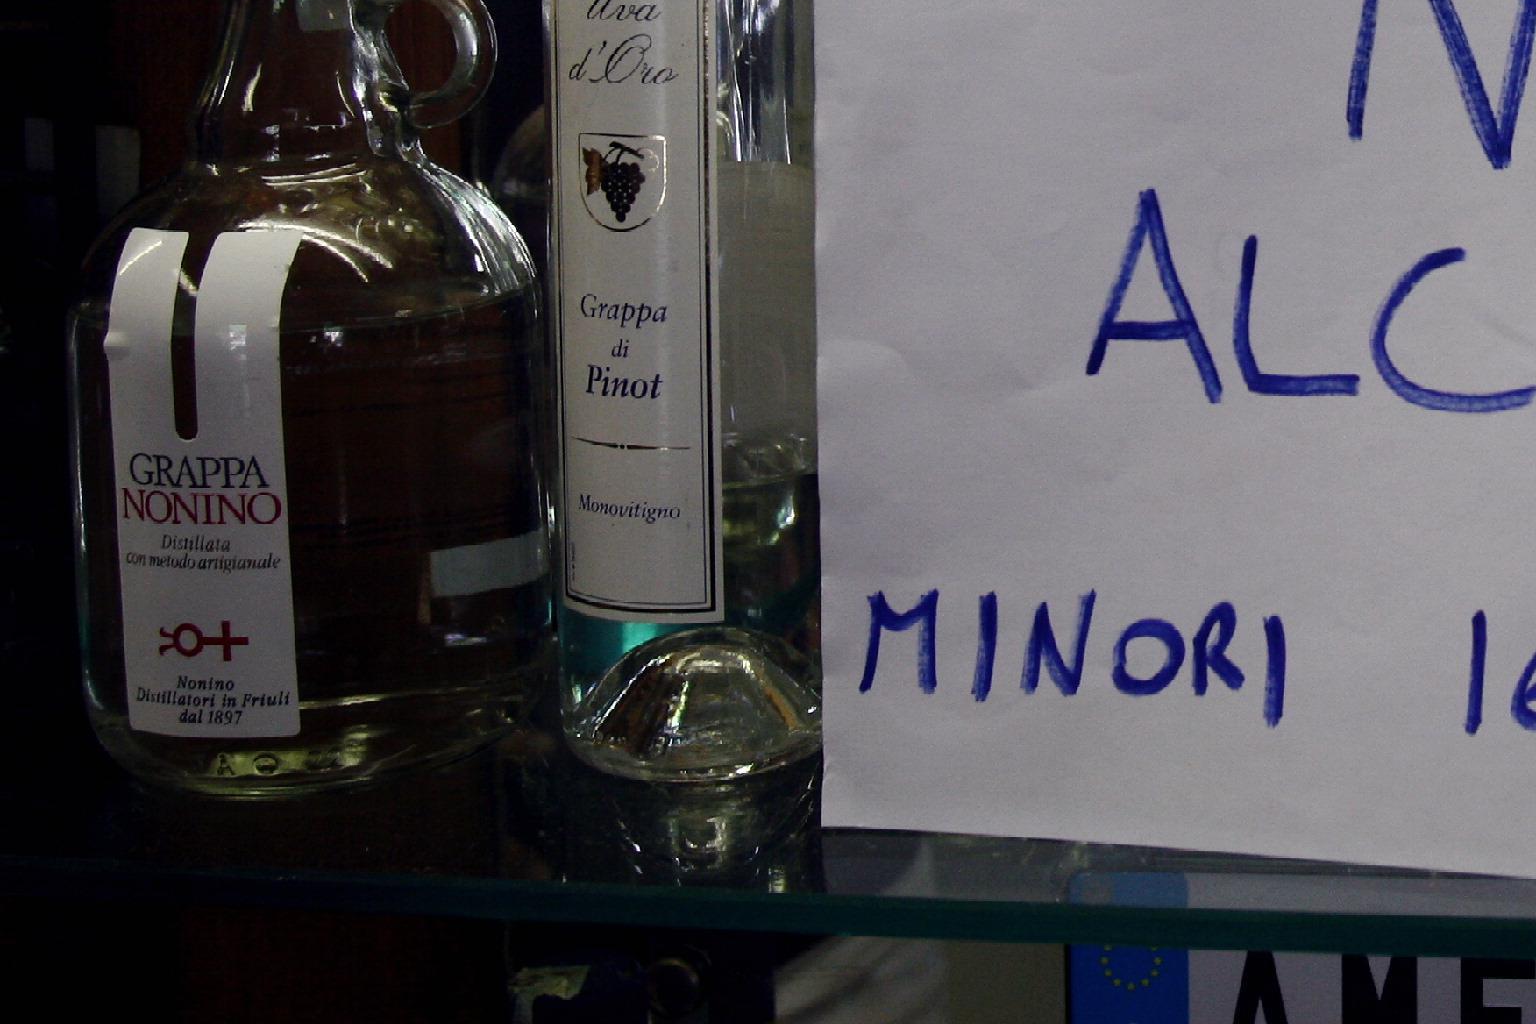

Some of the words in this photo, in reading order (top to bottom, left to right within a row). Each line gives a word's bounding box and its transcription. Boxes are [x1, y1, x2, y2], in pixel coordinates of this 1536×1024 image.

[569, 33, 680, 86] d'Oro
[579, 292, 668, 331] Grappa
[611, 337, 630, 359] di
[585, 364, 664, 402] Pinot
[130, 452, 270, 490] GRAPPA
[122, 488, 282, 525] NONINO
[577, 492, 682, 525] Monovitigno
[160, 534, 231, 553] Distillata
[126, 551, 147, 567] con
[149, 553, 197, 570] metodo
[197, 552, 281, 574] artigianale
[860, 589, 1287, 730] MINORI
[136, 686, 216, 709] Distillatori
[221, 692, 237, 708] in
[241, 690, 290, 708] Friuli
[176, 674, 236, 691] Nonino
[178, 708, 204, 725] dal
[207, 709, 244, 726] 1897
